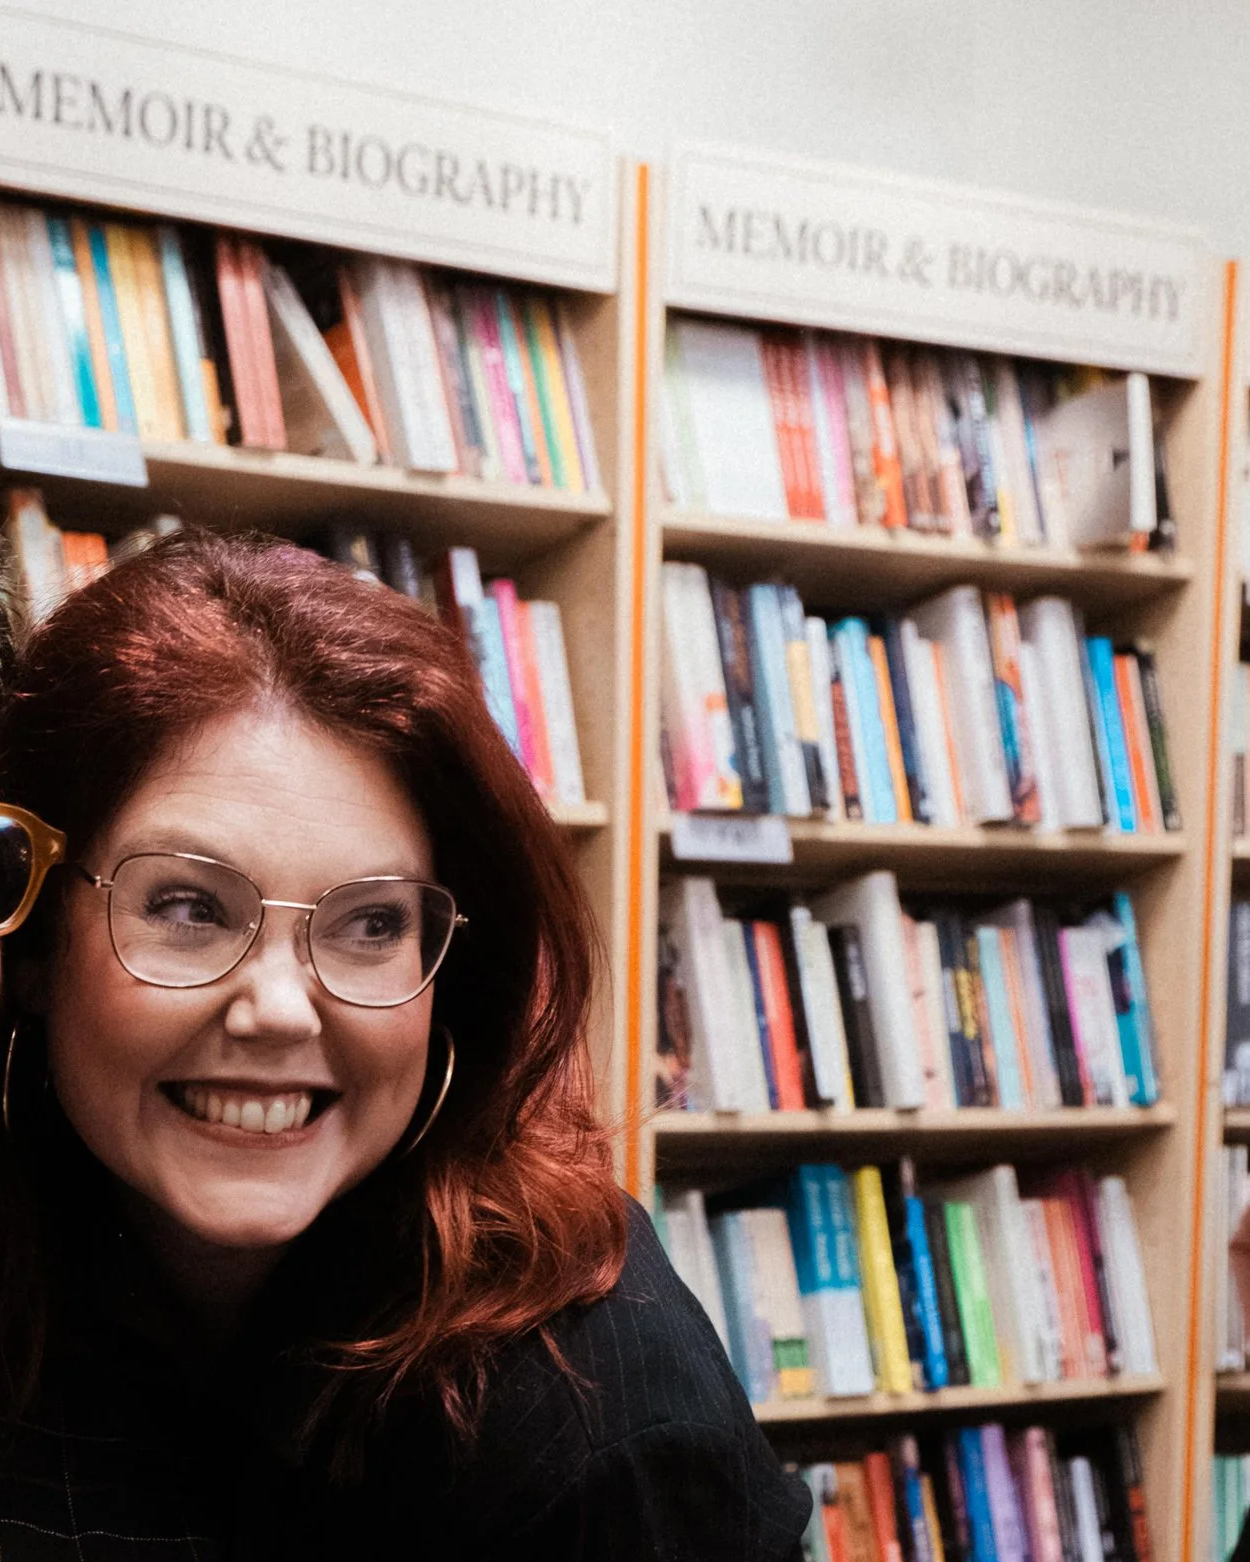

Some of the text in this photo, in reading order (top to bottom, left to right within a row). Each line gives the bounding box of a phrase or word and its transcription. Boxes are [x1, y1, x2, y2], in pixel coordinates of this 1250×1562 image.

[244, 112, 287, 173] &
[307, 123, 592, 226] BIOGRAPHY
[696, 204, 1186, 324] MEMOIR & BIOGRAPHY
